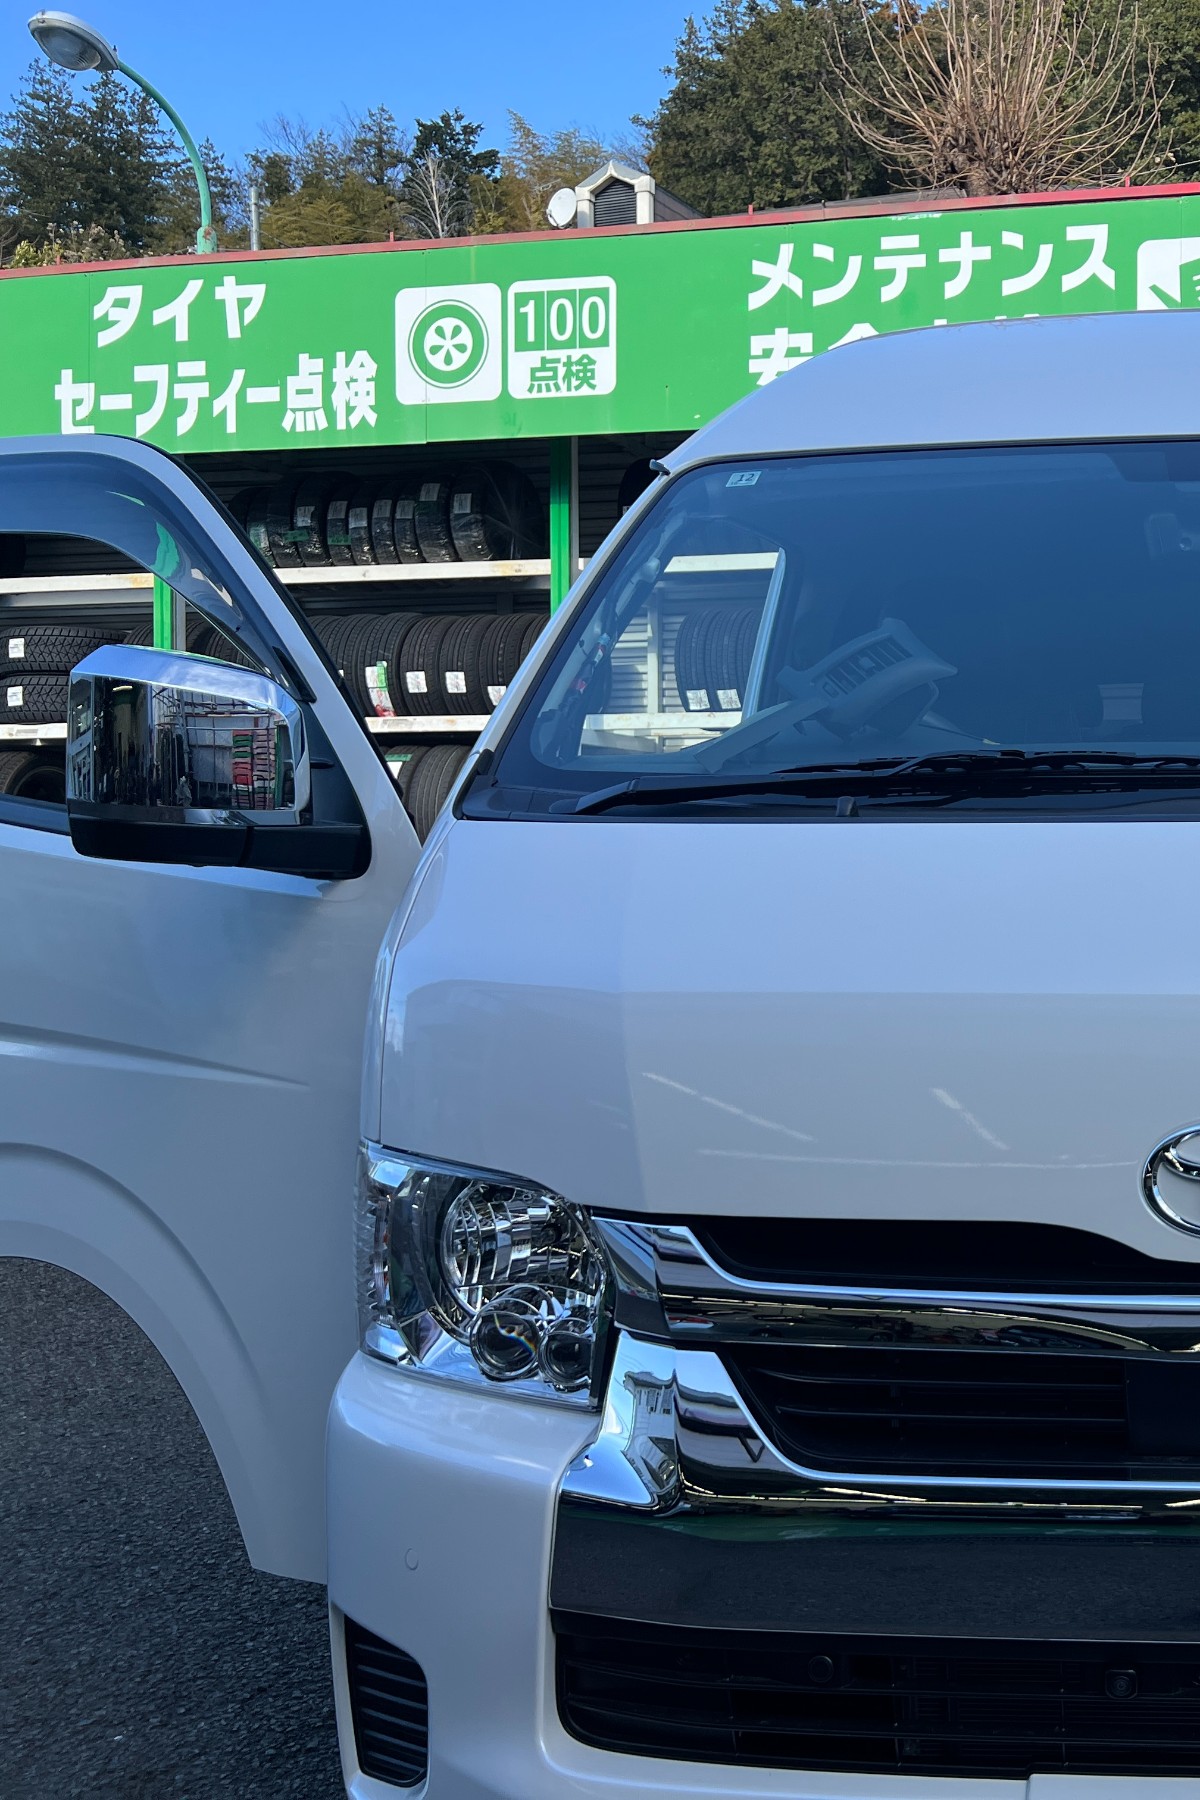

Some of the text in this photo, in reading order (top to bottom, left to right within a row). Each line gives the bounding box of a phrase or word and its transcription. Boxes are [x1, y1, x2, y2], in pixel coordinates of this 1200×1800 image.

[748, 223, 1116, 311] メンテナンス
[93, 275, 267, 348] タイヤ
[519, 295, 607, 343] 100
[55, 350, 379, 436] セーフティー点検
[527, 353, 598, 394] 点検
